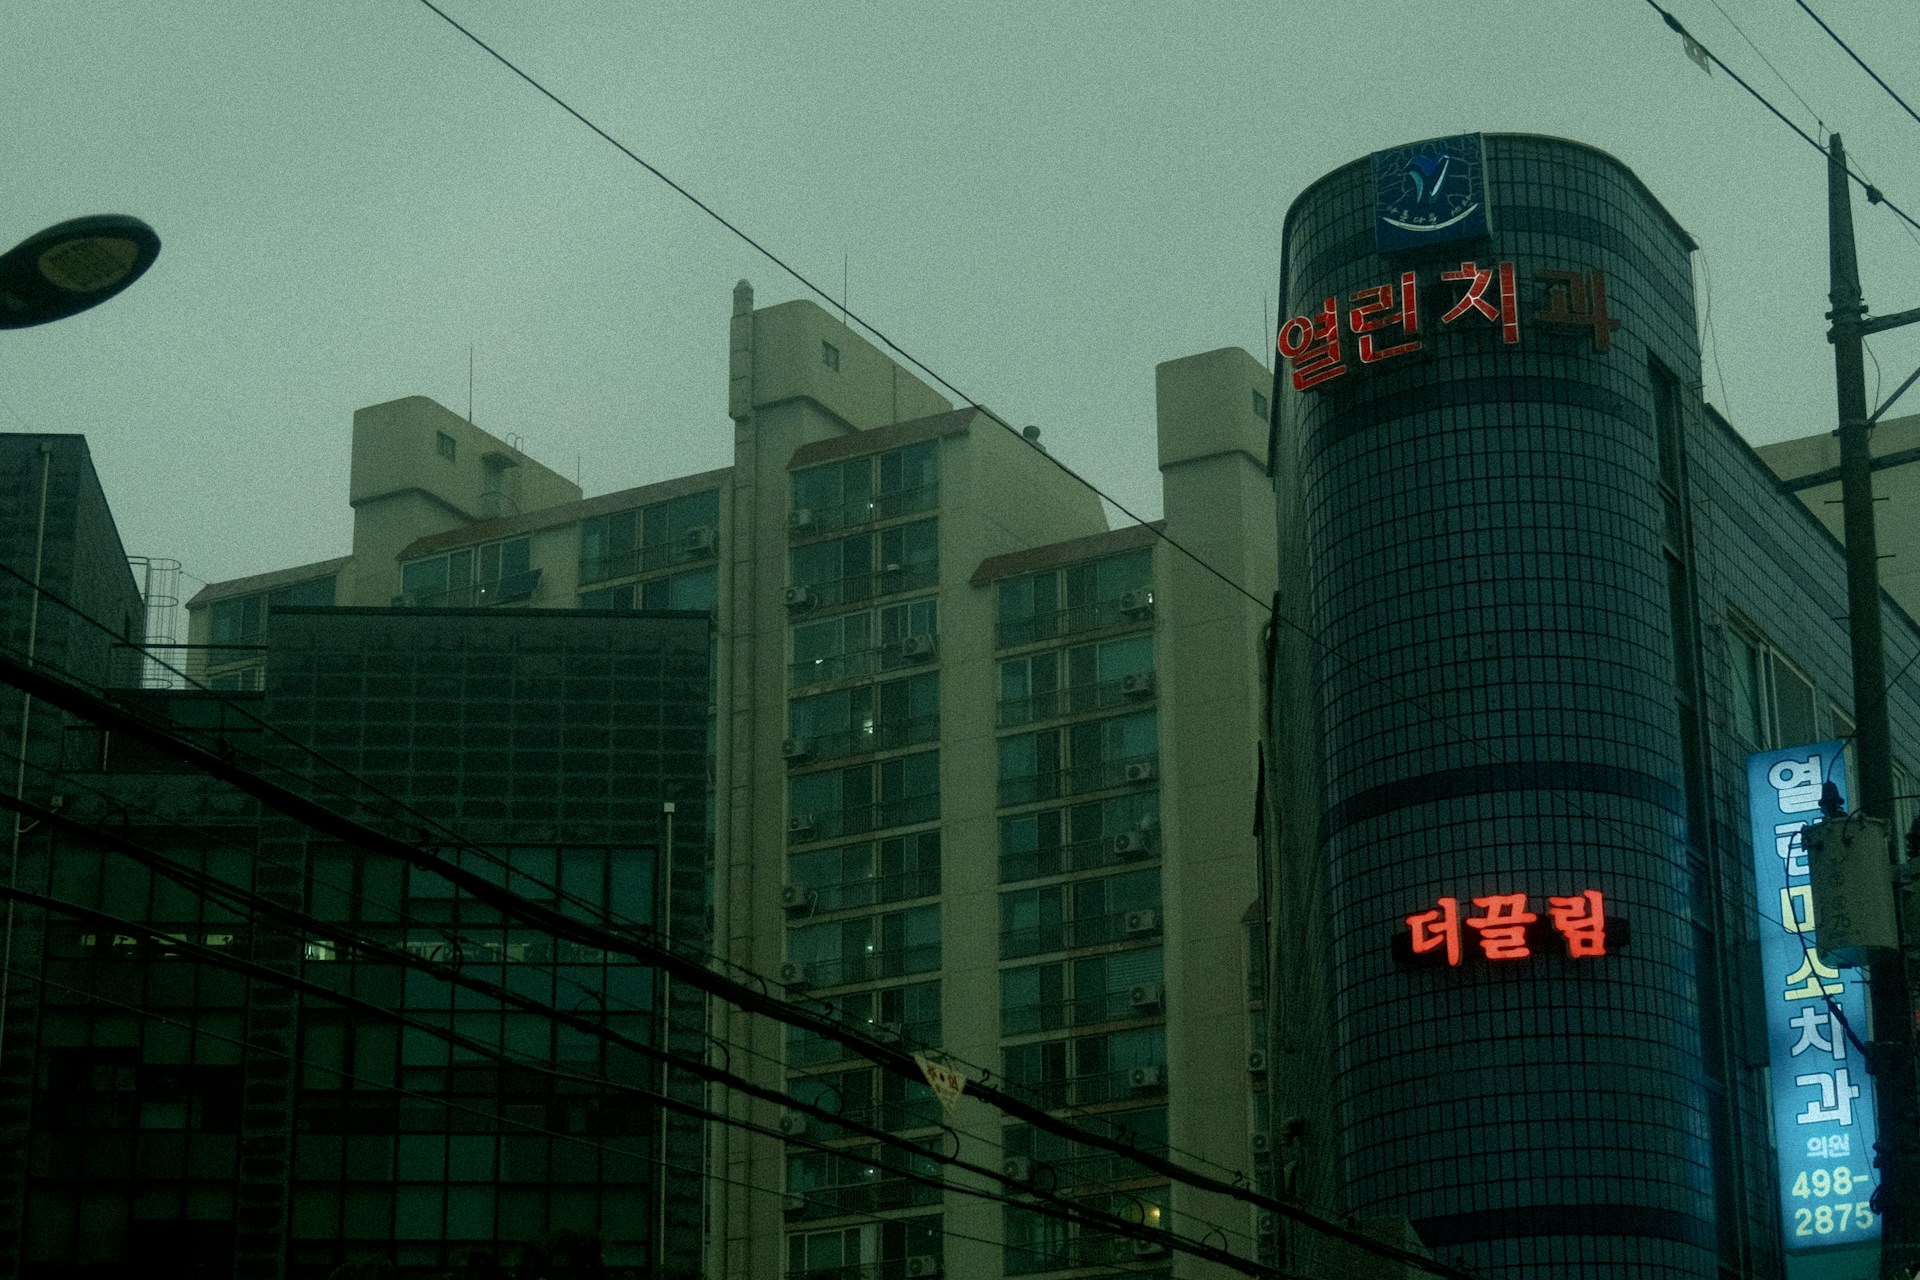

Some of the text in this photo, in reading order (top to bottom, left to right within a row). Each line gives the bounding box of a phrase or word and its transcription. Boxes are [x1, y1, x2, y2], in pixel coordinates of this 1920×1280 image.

[1806, 1133, 1851, 1158] 의원
[1791, 1166, 1869, 1198] 498-
[1794, 1202, 1874, 1237] 2875
